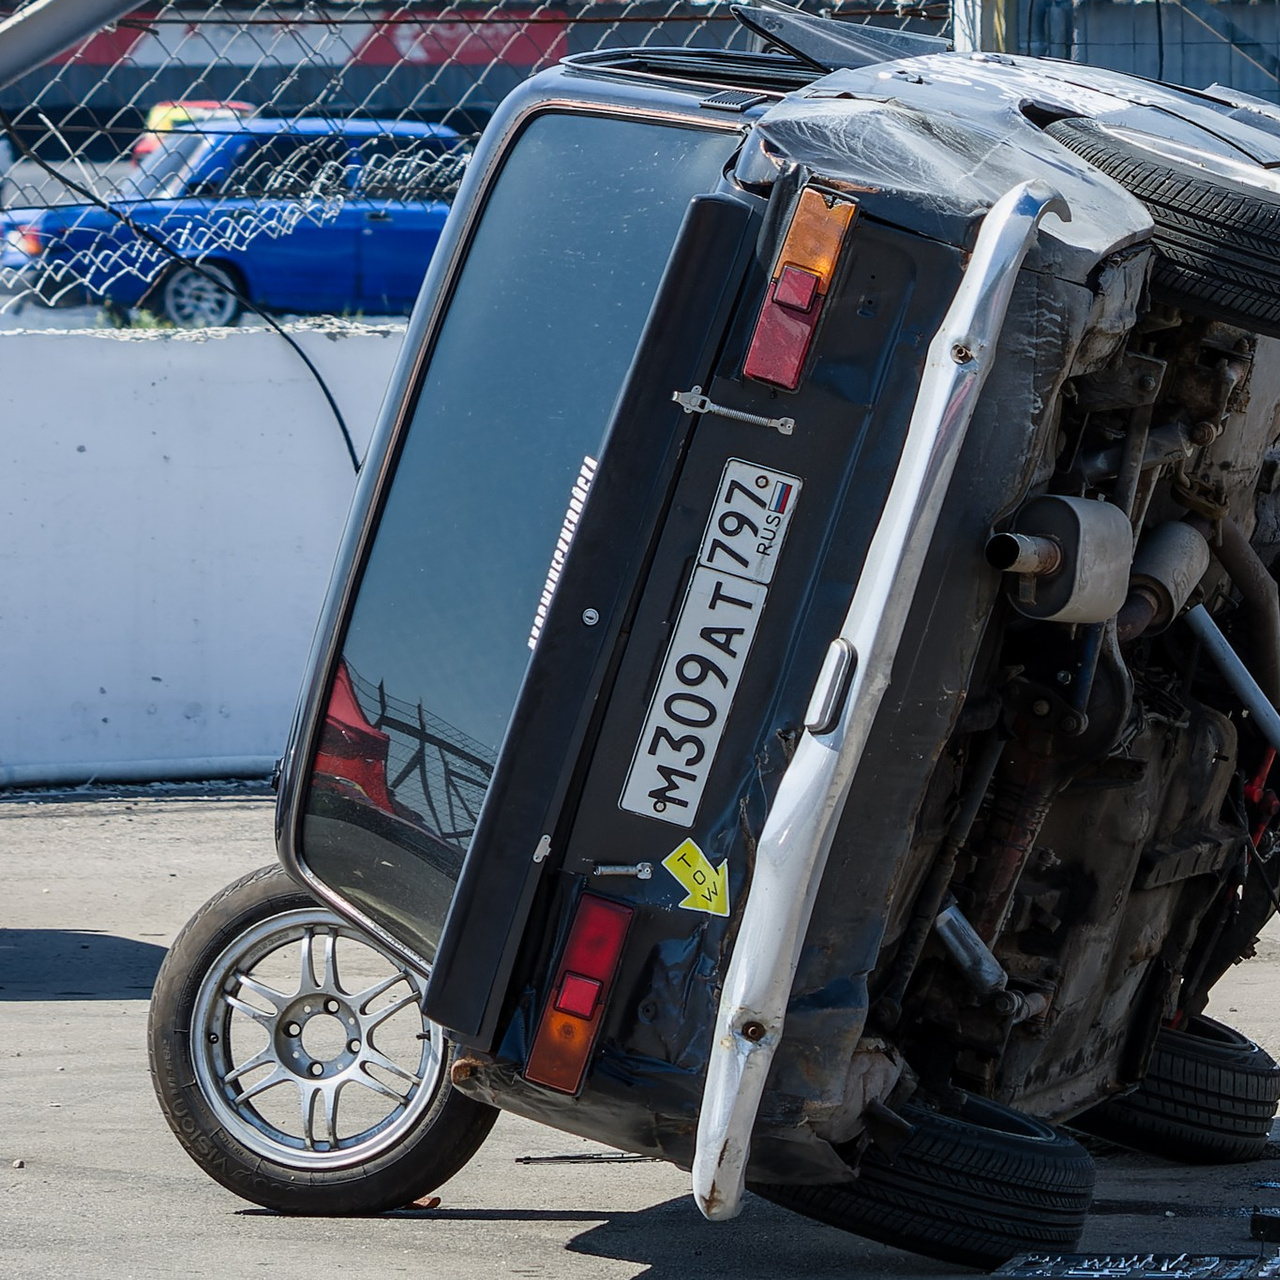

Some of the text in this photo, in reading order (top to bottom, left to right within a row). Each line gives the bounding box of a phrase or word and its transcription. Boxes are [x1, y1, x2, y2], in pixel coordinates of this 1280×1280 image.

[706, 479, 768, 569] 797
[756, 514, 782, 557] RUS
[677, 853, 719, 903] TOW
